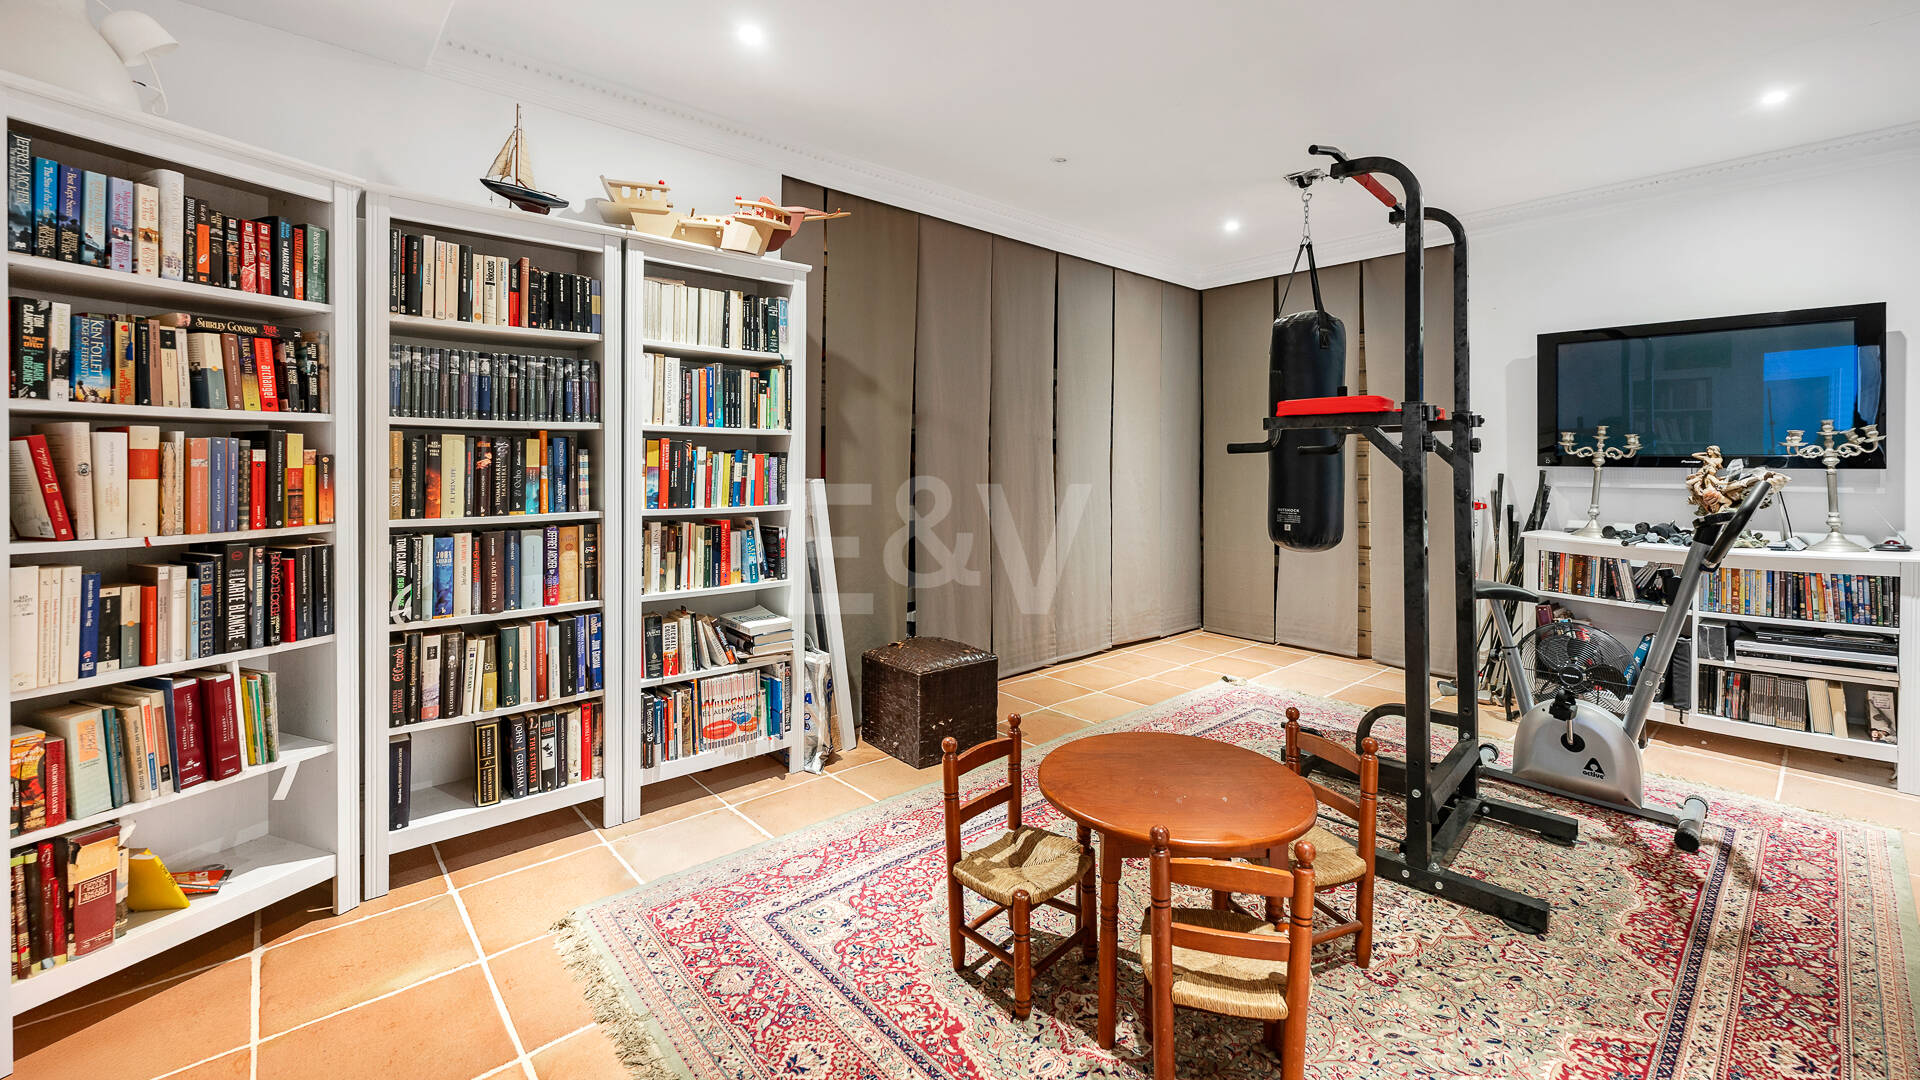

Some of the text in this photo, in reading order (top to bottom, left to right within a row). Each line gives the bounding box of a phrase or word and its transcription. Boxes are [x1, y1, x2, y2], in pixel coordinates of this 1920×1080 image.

[14, 135, 31, 204] JEFFREY ARCHER
[65, 173, 77, 217] Best Kept Secret
[200, 205, 208, 213] Life
[186, 198, 196, 230] JEFFREY ARCHER
[282, 247, 291, 274] MARRIAGE
[282, 275, 290, 288] PACT
[23, 304, 34, 335] CLANCY'S
[34, 314, 45, 328] TOM
[196, 317, 227, 333] SHIRLEY
[81, 318, 90, 378] EDGE OF ETERNITY
[90, 319, 105, 384] KEN FOLLETT
[23, 355, 34, 386] GREANEY
[34, 362, 45, 381] MARK
[261, 365, 276, 399] archangel
[391, 480, 401, 507] THE KISS
[513, 469, 522, 489] Ocho
[396, 537, 407, 577] TOM CLANCY
[547, 529, 558, 570] JEFFREY ARCHER
[271, 554, 280, 617] PEDRO EL GRANDE
[229, 577, 246, 641] CARTE BLANCHE
[592, 640, 601, 651] JOHN
[592, 651, 601, 669] GRISHAM
[513, 723, 525, 789] JOHN GRISHAM
[1582, 770, 1605, 780] active
